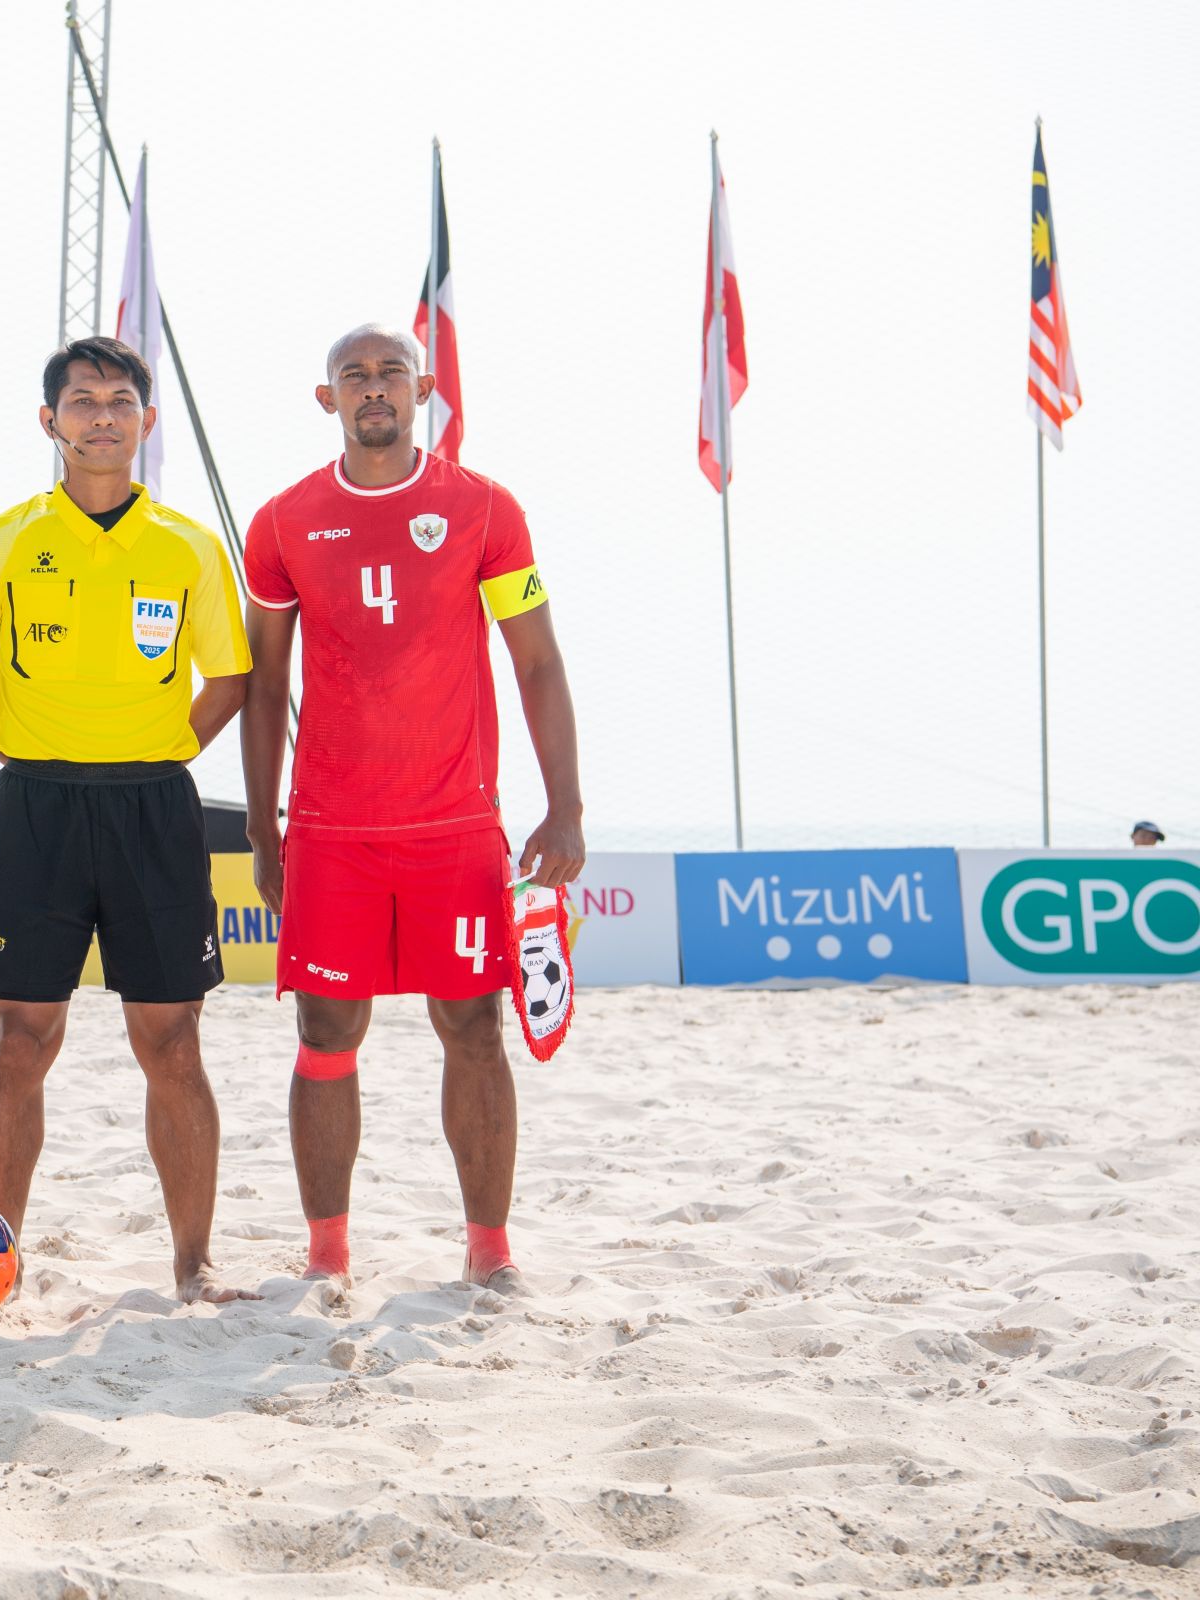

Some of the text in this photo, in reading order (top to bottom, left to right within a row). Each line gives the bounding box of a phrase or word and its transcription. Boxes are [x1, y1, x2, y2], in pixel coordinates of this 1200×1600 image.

[307, 528, 351, 541] erspo
[360, 564, 398, 624] 4
[137, 601, 173, 619] FIFA
[23, 623, 67, 643] AFC
[140, 630, 170, 639] REFEREE
[143, 646, 161, 655] 2025
[567, 887, 635, 916] ND
[717, 871, 932, 927] MizuMi
[1001, 877, 1200, 955] GPO
[455, 916, 488, 974] 4
[306, 962, 349, 982] erspo
[527, 959, 544, 967] IRAN
